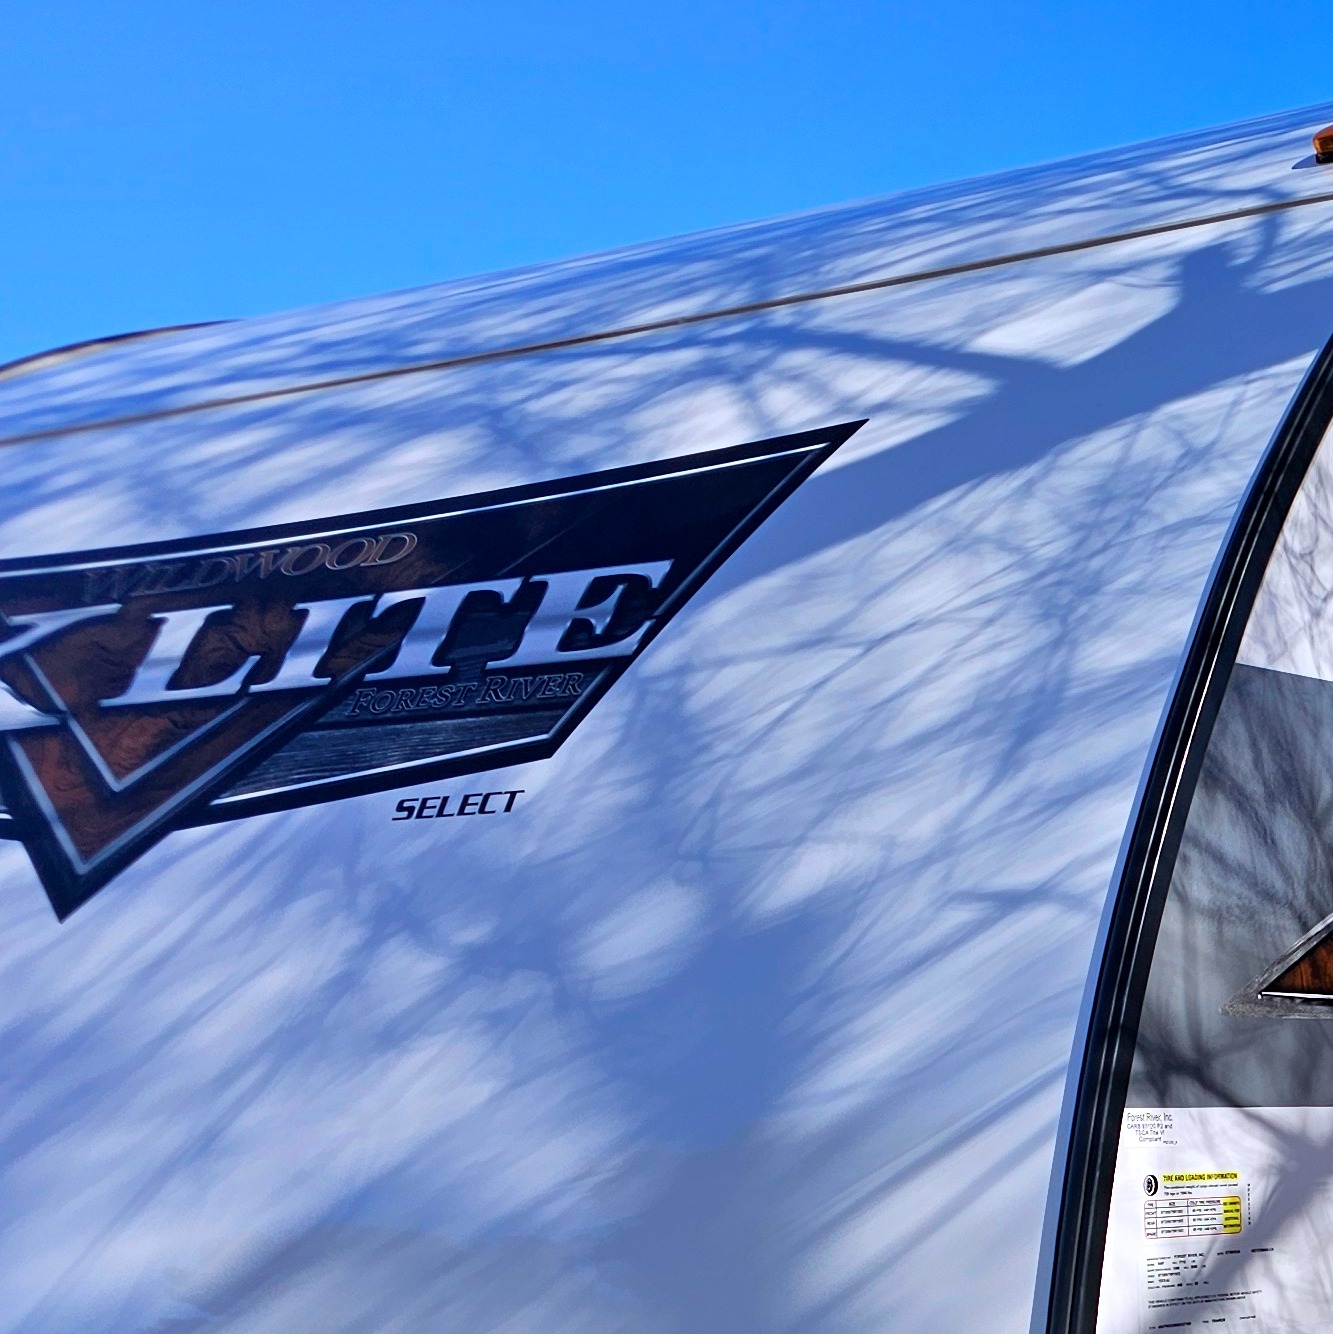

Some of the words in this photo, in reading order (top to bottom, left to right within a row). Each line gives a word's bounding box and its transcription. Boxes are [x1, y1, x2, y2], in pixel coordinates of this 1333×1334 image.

[84, 532, 418, 600] WILDWOOD
[345, 682, 478, 716] FOREST
[476, 672, 585, 704] RIVER
[391, 789, 526, 821] SELECT
[1207, 1172, 1238, 1180] INFORMATION
